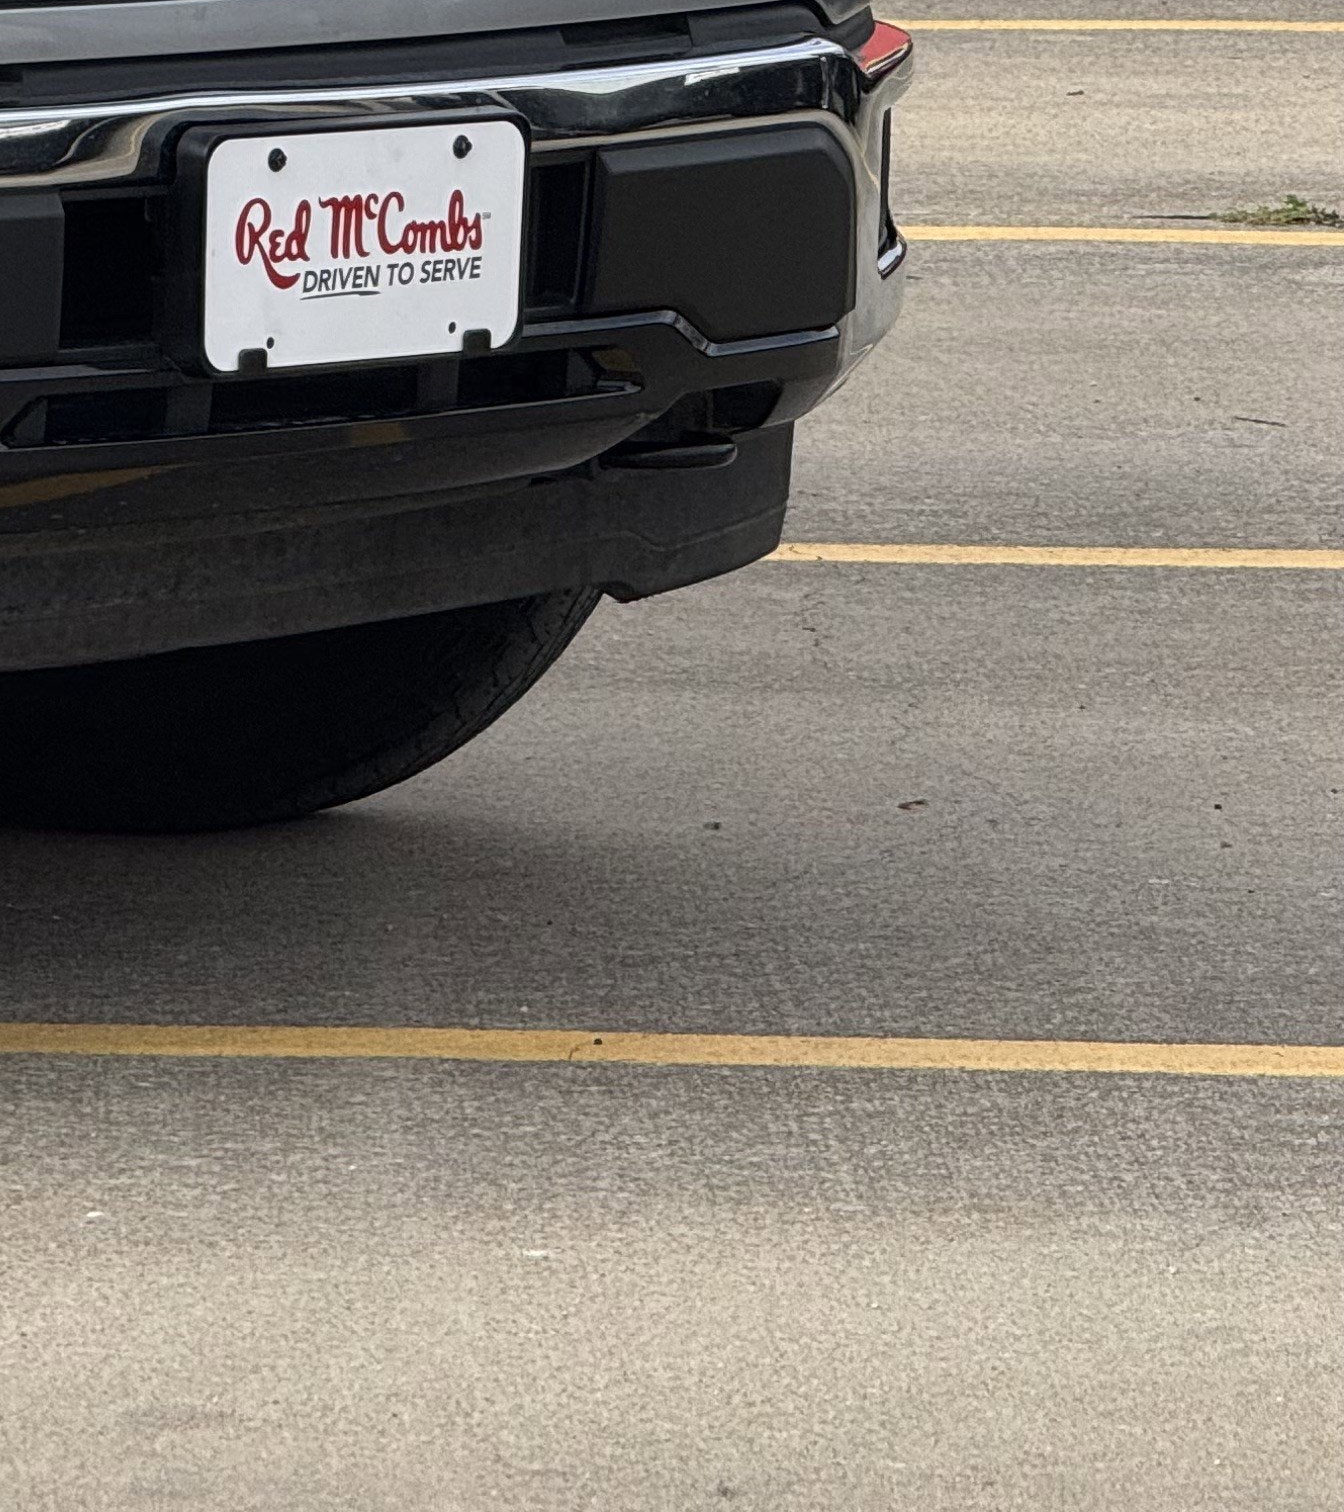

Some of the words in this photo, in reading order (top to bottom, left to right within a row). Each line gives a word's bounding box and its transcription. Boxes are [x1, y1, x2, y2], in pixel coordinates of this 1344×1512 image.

[235, 197, 311, 290] Red
[318, 189, 483, 260] McCombs
[302, 264, 381, 294] DRIVEN
[386, 261, 415, 287] TO
[419, 256, 482, 285] SERVE
